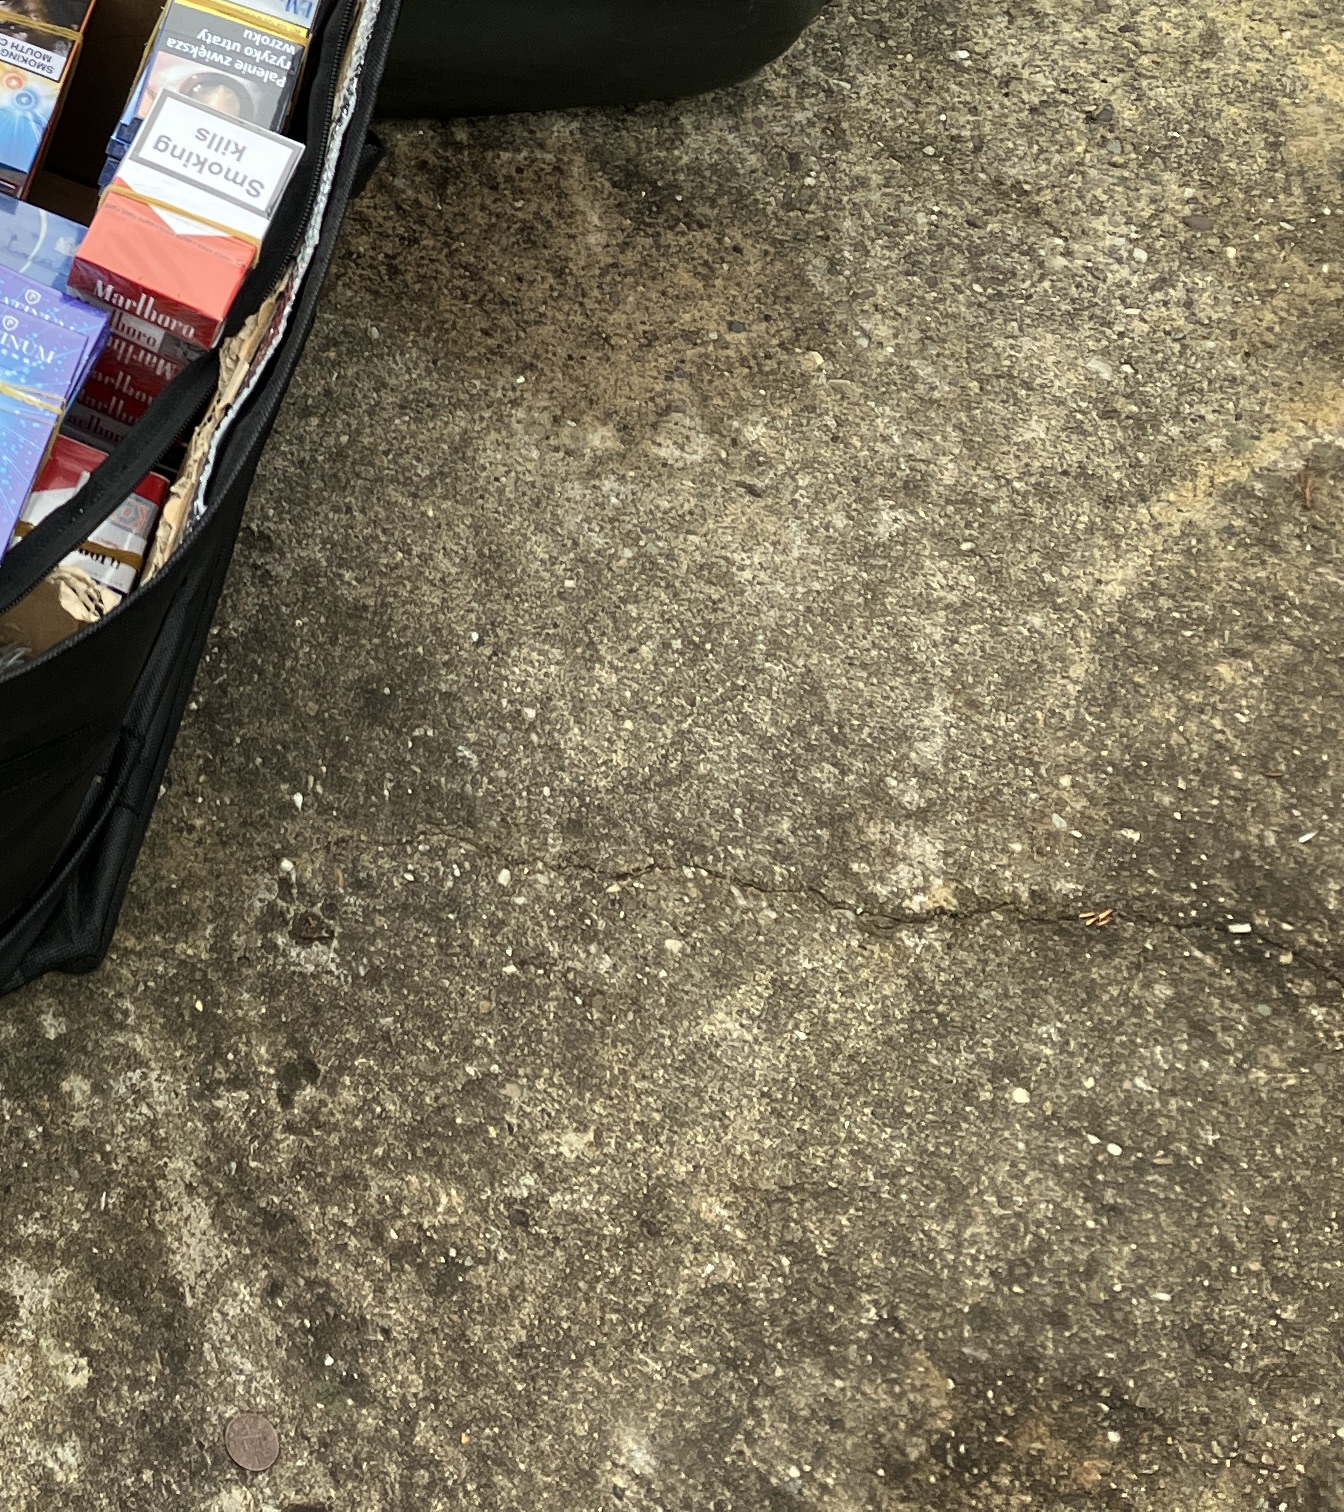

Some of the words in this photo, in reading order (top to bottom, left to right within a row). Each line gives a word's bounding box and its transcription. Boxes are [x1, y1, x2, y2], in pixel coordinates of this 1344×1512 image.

[11, 41, 52, 63] MOUTH
[166, 37, 232, 68] zwiększa
[196, 29, 241, 52] utraty
[242, 28, 296, 56] wzroku
[0, 48, 55, 75] SMOKING
[243, 42, 292, 70] ryzyko
[235, 59, 287, 87] Palenie
[195, 126, 246, 161] kills
[152, 135, 265, 198] Smoking
[94, 279, 196, 340] Marlboro
